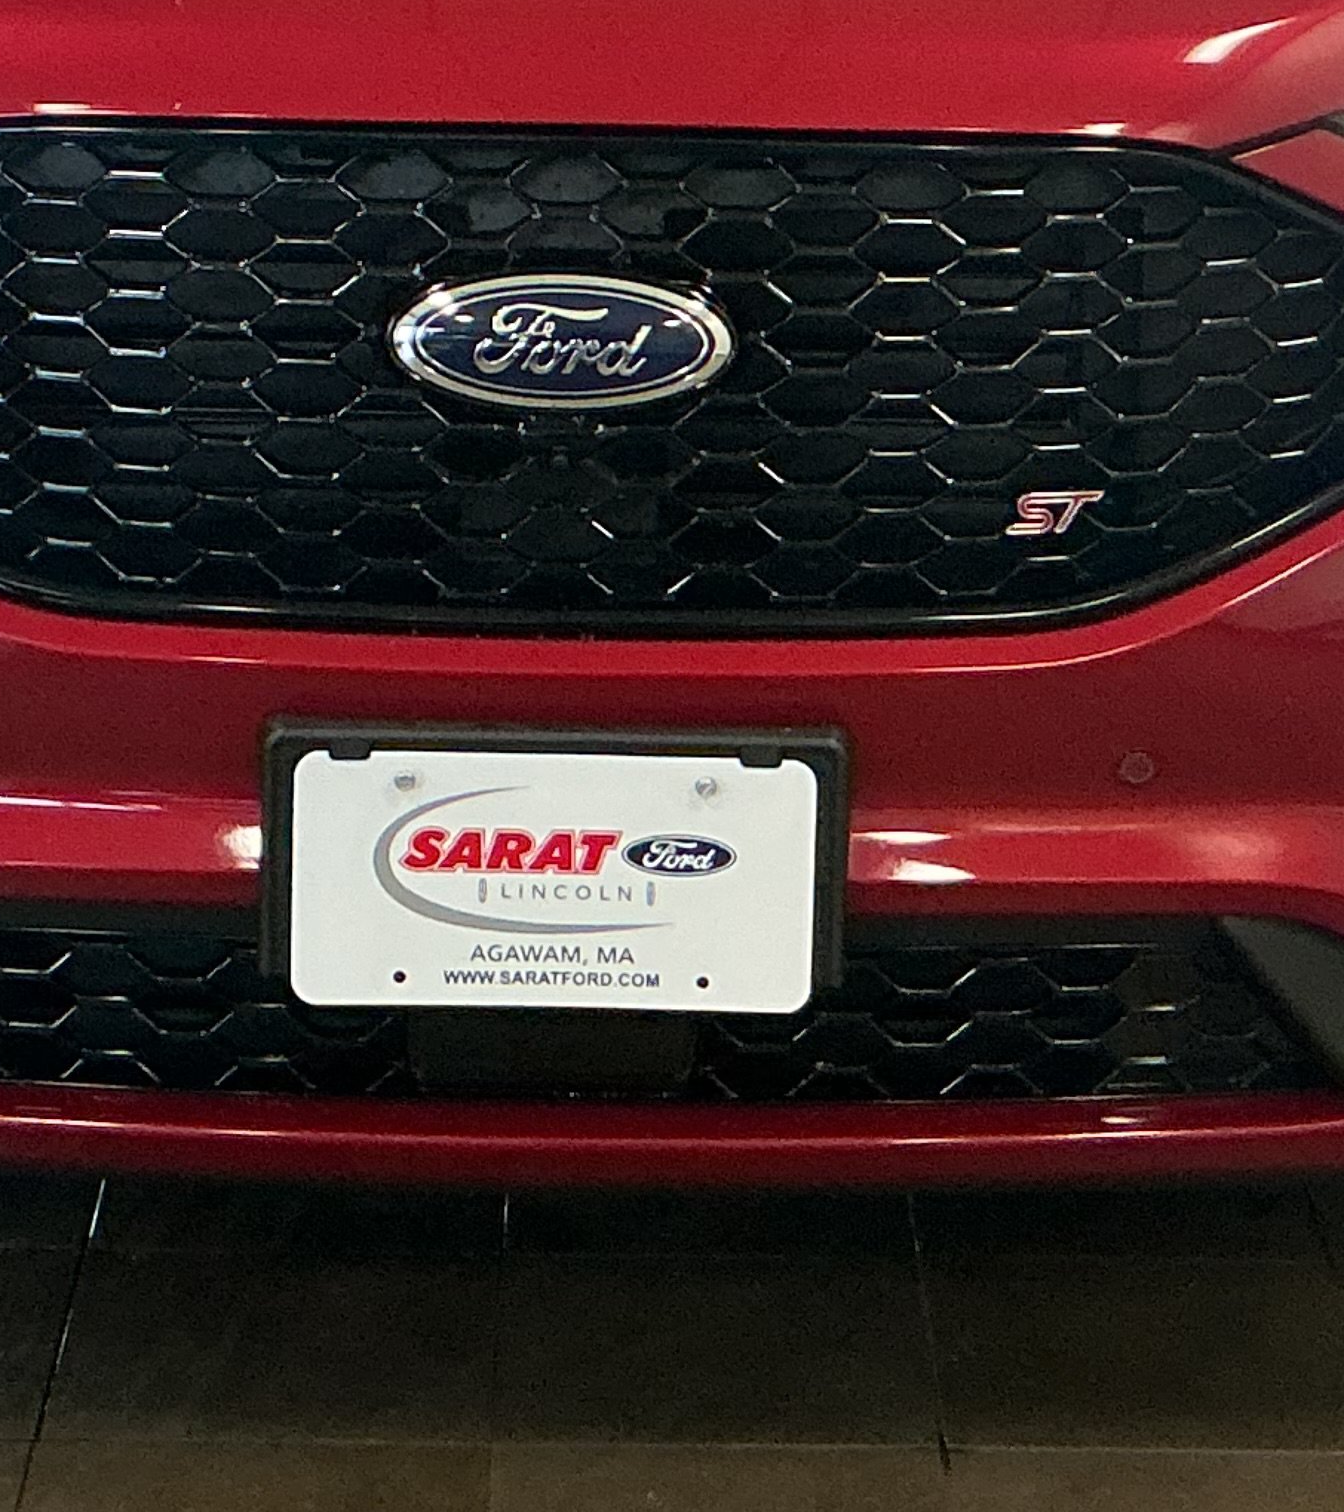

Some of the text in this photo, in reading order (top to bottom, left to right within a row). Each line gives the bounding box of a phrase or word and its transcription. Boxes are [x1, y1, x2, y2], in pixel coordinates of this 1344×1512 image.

[472, 302, 653, 378] Ford
[1006, 490, 1105, 535] ST
[400, 826, 716, 875] SARAT Ford
[501, 883, 633, 902] LINCOLN
[470, 944, 635, 966] AGAWAM, MA
[443, 970, 660, 988] WWW.SARATFORD.COM
